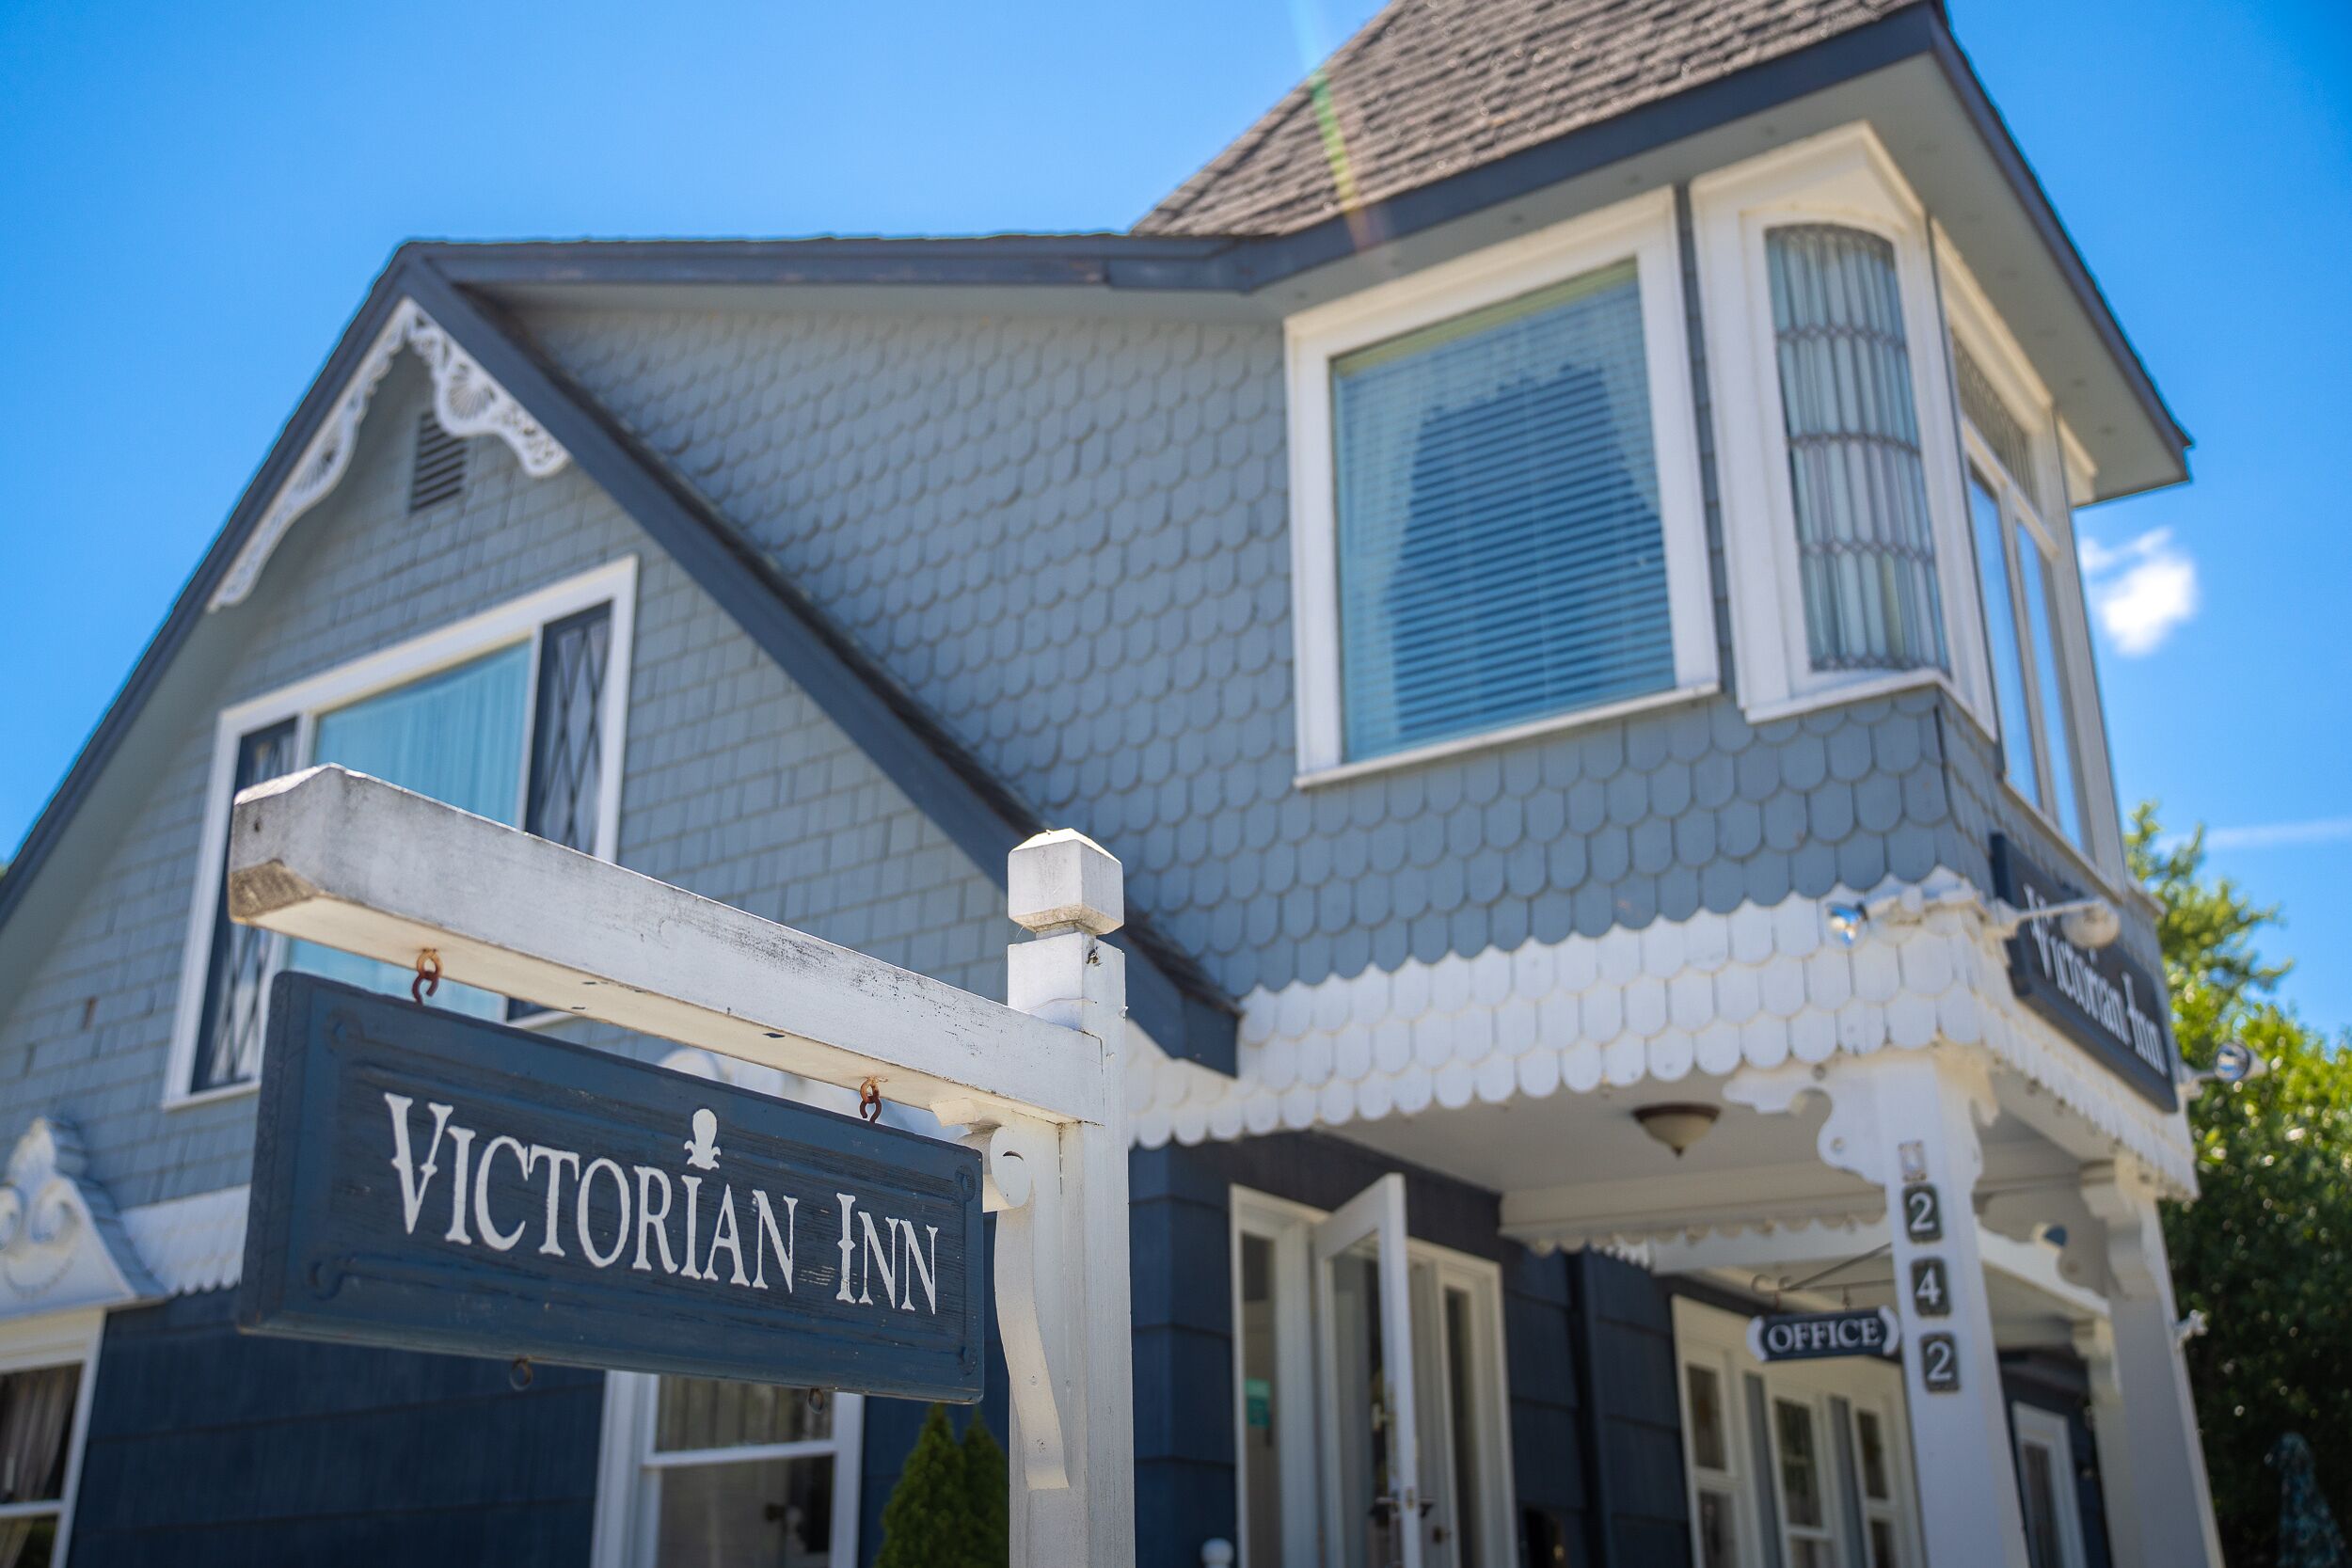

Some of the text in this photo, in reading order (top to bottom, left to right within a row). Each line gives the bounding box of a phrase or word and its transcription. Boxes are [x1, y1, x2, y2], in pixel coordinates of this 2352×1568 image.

[2122, 971, 2169, 1078] Inn
[383, 1092, 939, 1315] VICTORIAN INN
[1767, 1317, 1882, 1354] OFFICE
